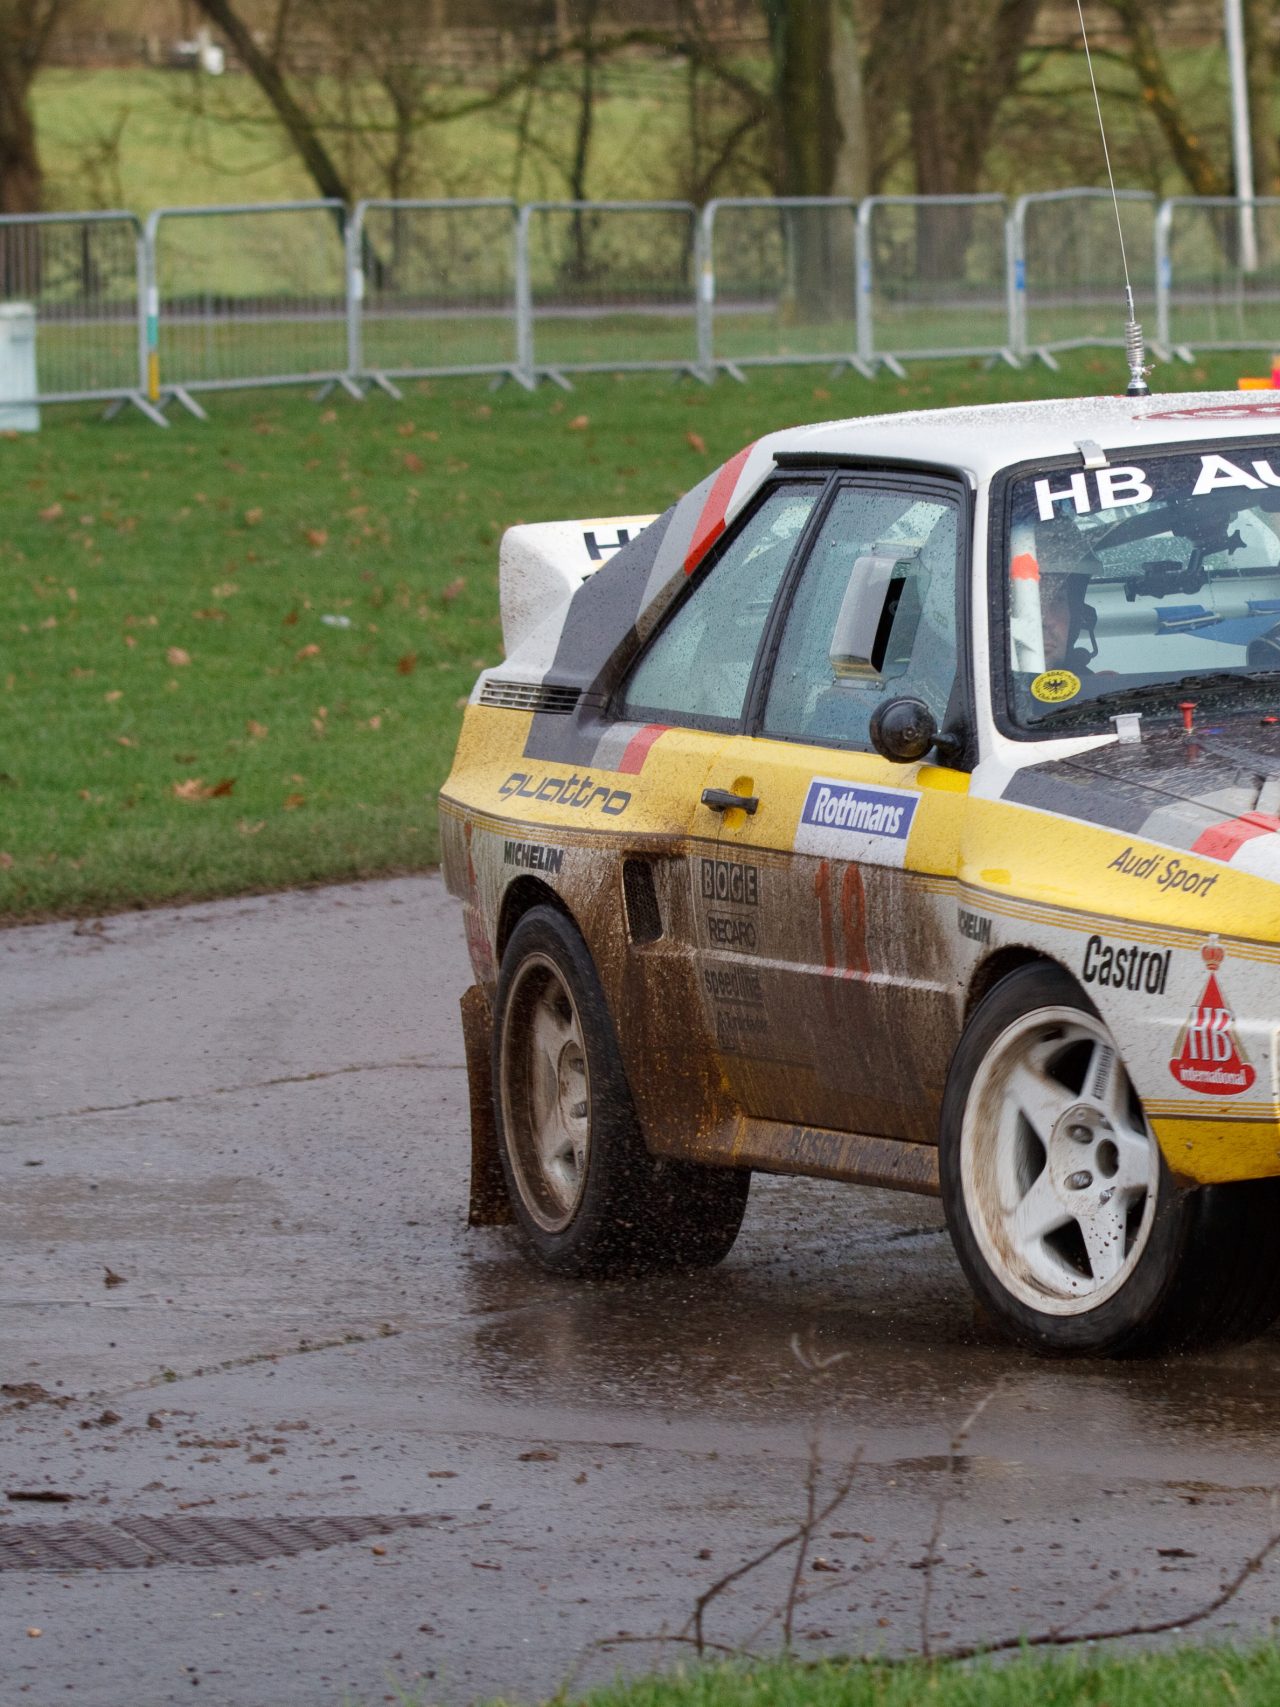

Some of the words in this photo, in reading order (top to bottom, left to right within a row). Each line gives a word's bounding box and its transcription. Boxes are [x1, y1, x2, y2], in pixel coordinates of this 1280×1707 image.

[1033, 465, 1154, 522] HB
[583, 527, 646, 561] H
[497, 772, 633, 816] quattro
[810, 786, 906, 835] Rothmans
[503, 840, 565, 874] MICHELIN
[1106, 846, 1165, 880] Audi
[1157, 859, 1220, 898] Sport
[703, 862, 757, 903] BOGE
[708, 916, 757, 948] RECARO
[1081, 934, 1172, 995] Castrol
[1188, 1006, 1234, 1063] HB
